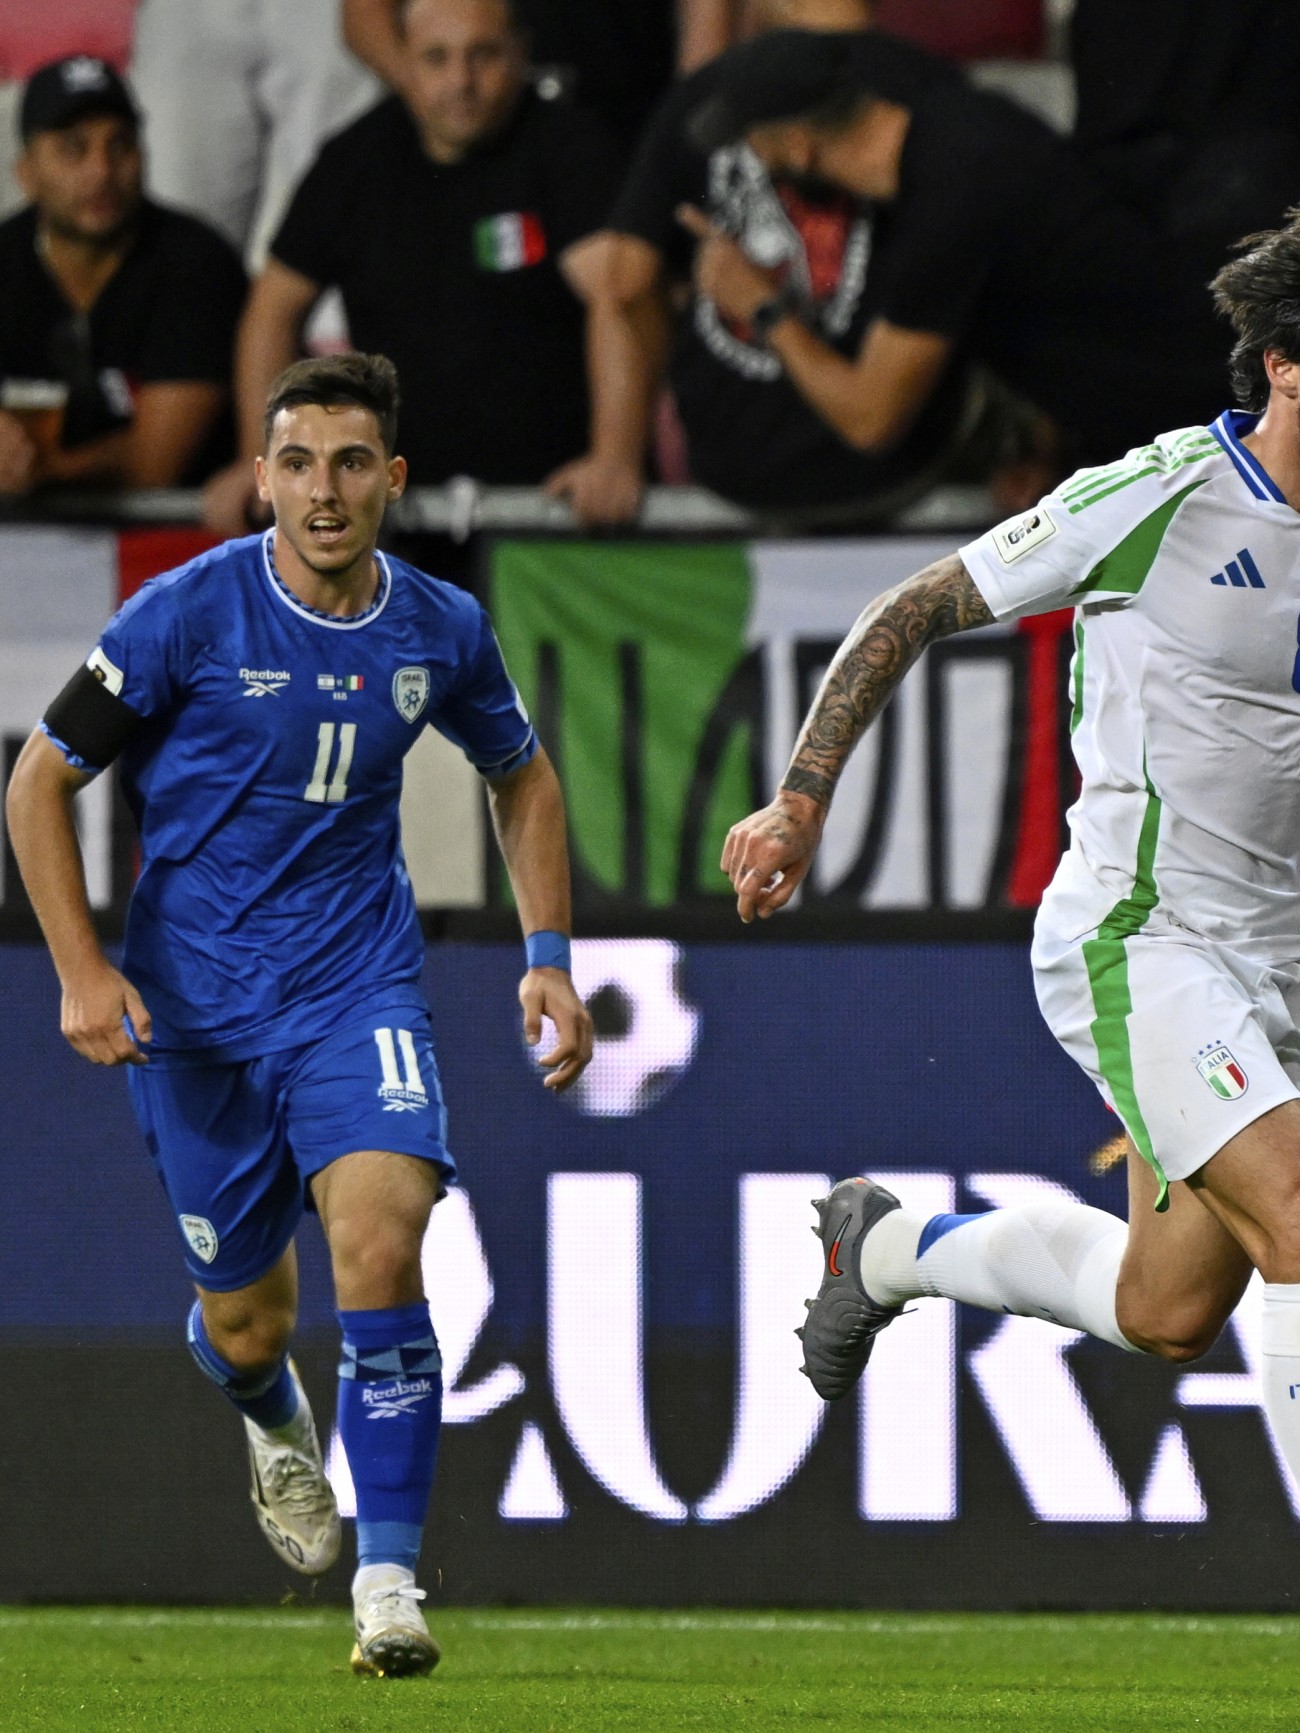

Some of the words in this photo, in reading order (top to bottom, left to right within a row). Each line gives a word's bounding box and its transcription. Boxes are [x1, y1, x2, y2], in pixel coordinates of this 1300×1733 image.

[239, 668, 291, 681] Reebok
[304, 722, 357, 803] 11
[374, 1027, 426, 1094] 11
[1200, 1051, 1230, 1074] ALIA
[378, 1088, 429, 1105] Reebok
[362, 1379, 433, 1405] Reebok
